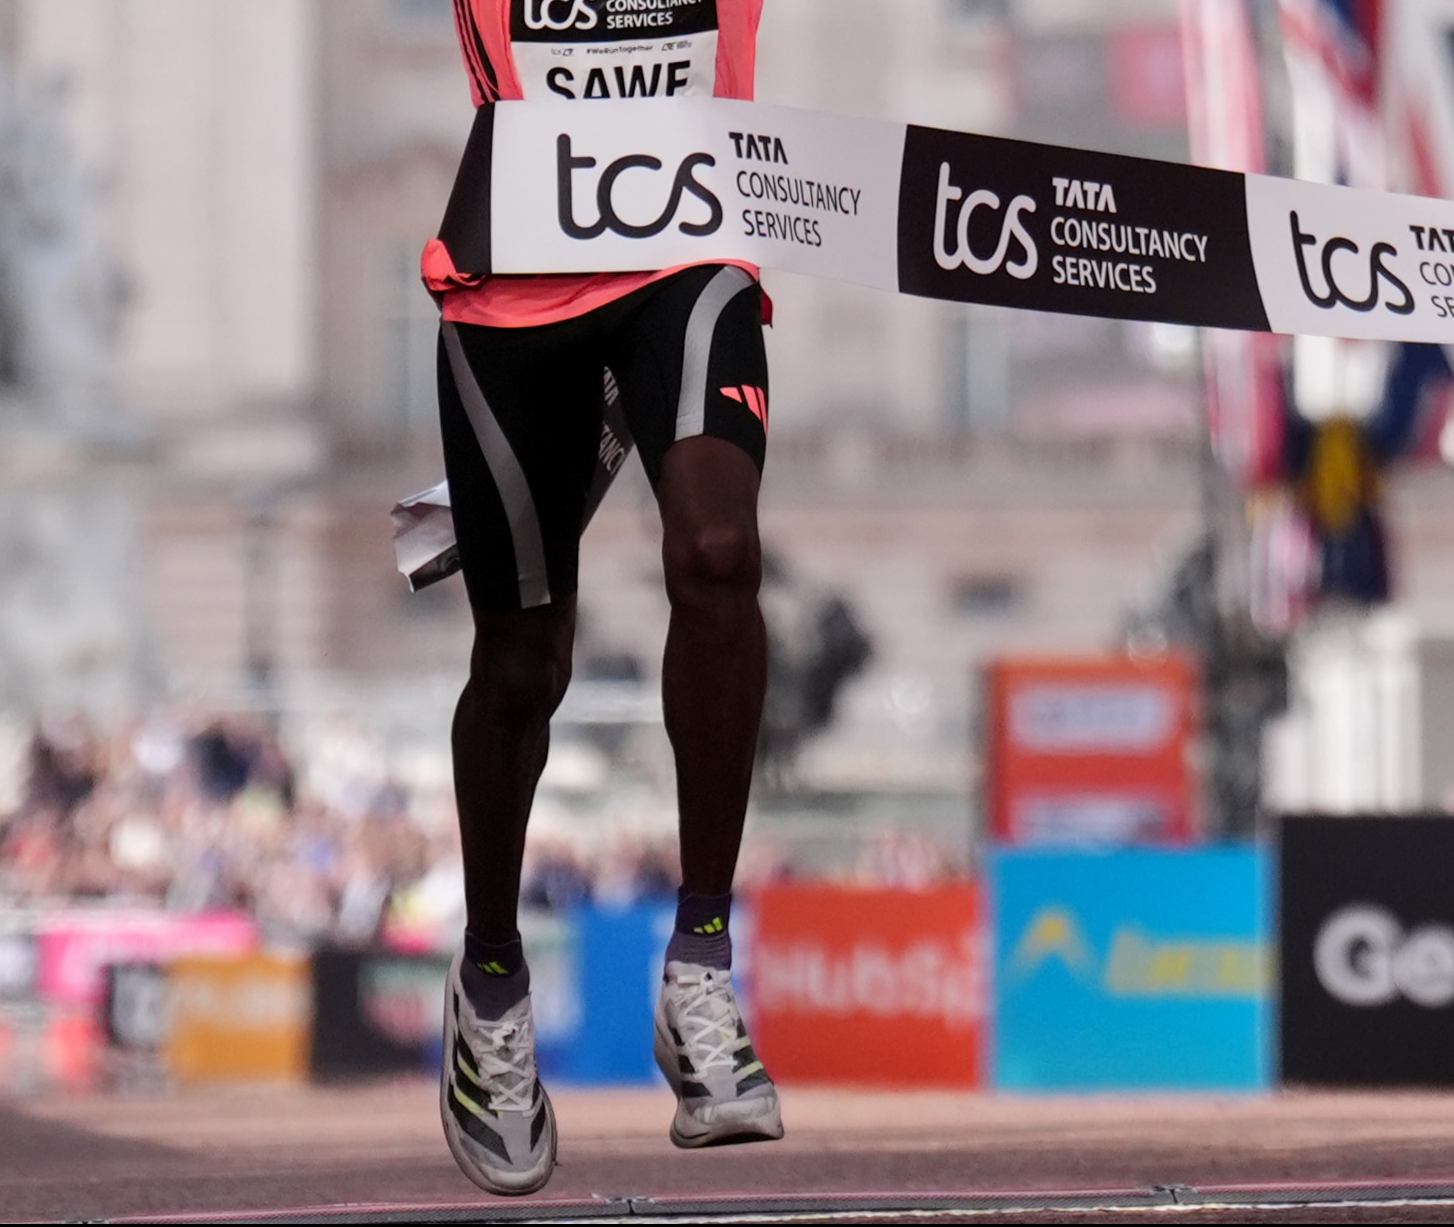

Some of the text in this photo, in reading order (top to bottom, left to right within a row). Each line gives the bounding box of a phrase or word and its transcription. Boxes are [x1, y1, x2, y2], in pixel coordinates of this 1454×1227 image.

[606, 11, 673, 29] SERVICES
[729, 132, 788, 165] TATA
[557, 133, 723, 240] tcs
[736, 170, 861, 216] CONSULTANCY
[1052, 177, 1117, 214] TATA
[742, 210, 823, 247] SERVICES
[933, 161, 1037, 279] tcs
[1050, 216, 1209, 264] CONSULTANCY
[1052, 260, 1157, 295] SERVICES
[1289, 210, 1415, 315] tcs
